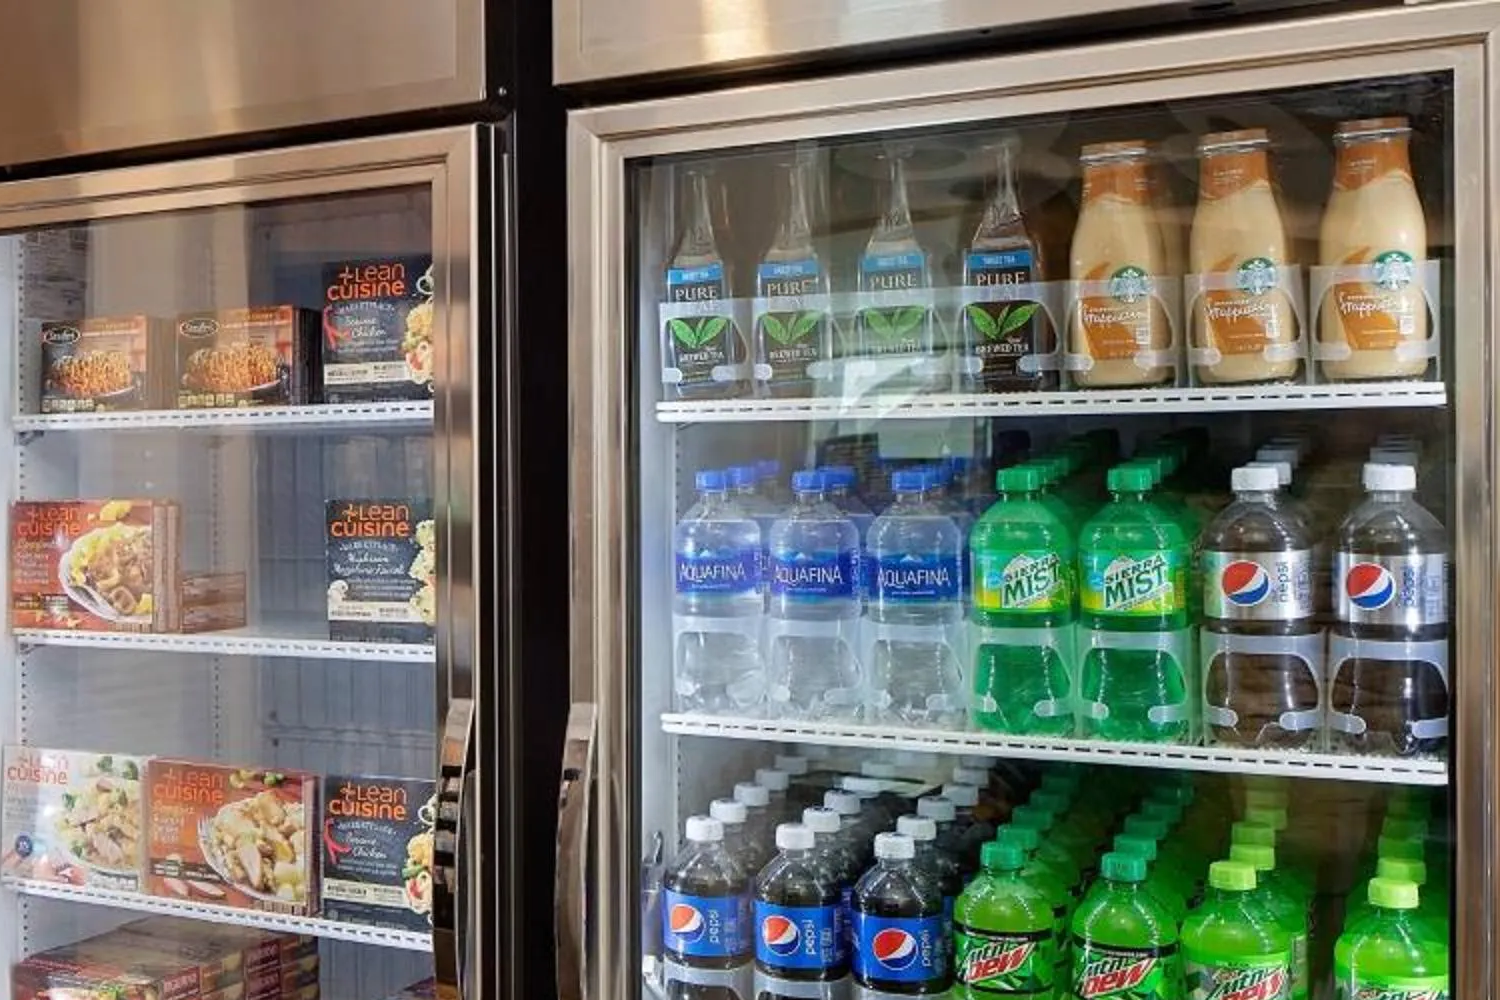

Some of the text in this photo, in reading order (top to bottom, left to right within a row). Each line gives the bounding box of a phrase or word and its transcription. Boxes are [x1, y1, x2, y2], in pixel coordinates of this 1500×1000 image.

[355, 263, 405, 283] Lean
[870, 273, 917, 289] PURE
[976, 271, 1025, 287] PURE
[327, 281, 405, 300] cuisine
[675, 285, 717, 301] PURE
[767, 280, 812, 296] PURE
[360, 505, 409, 521] Lean
[331, 521, 410, 537] cuisine
[680, 562, 746, 583] AQUAFINA
[774, 564, 843, 586] AQUAFINA
[878, 567, 951, 588] AQUAFINA
[1105, 554, 1167, 585] SIERRA
[1003, 564, 1060, 607] MIST
[1105, 565, 1166, 609] MIST
[357, 784, 408, 804] Lean
[329, 799, 407, 821] cuisine
[708, 910, 720, 945] pepsi
[802, 919, 817, 955] pepsi
[922, 929, 933, 967] pepsi
